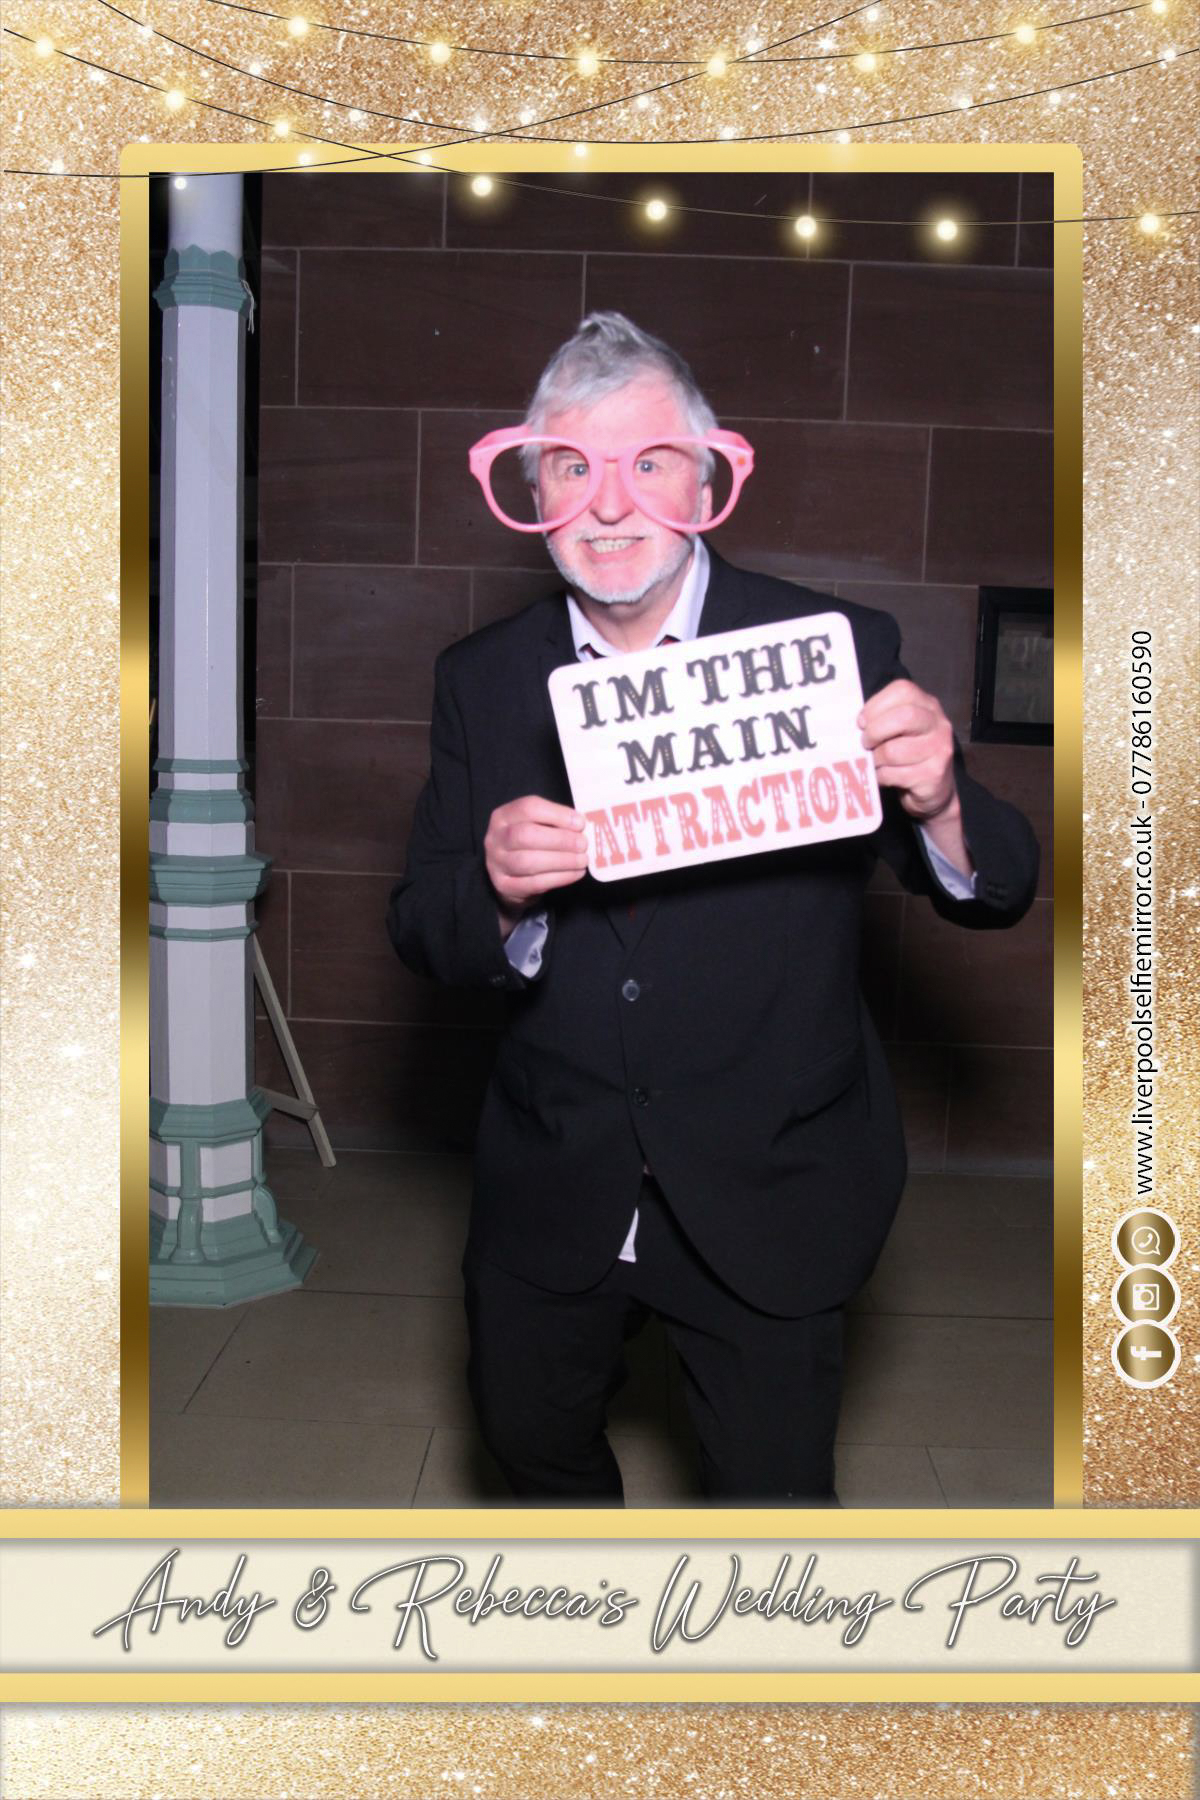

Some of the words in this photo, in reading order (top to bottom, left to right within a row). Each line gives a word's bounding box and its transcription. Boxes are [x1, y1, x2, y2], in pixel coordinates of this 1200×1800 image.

[572, 666, 675, 730] IM
[686, 634, 836, 706] THE
[617, 705, 817, 785] MAIN
[585, 757, 874, 869] ATTRACTION
